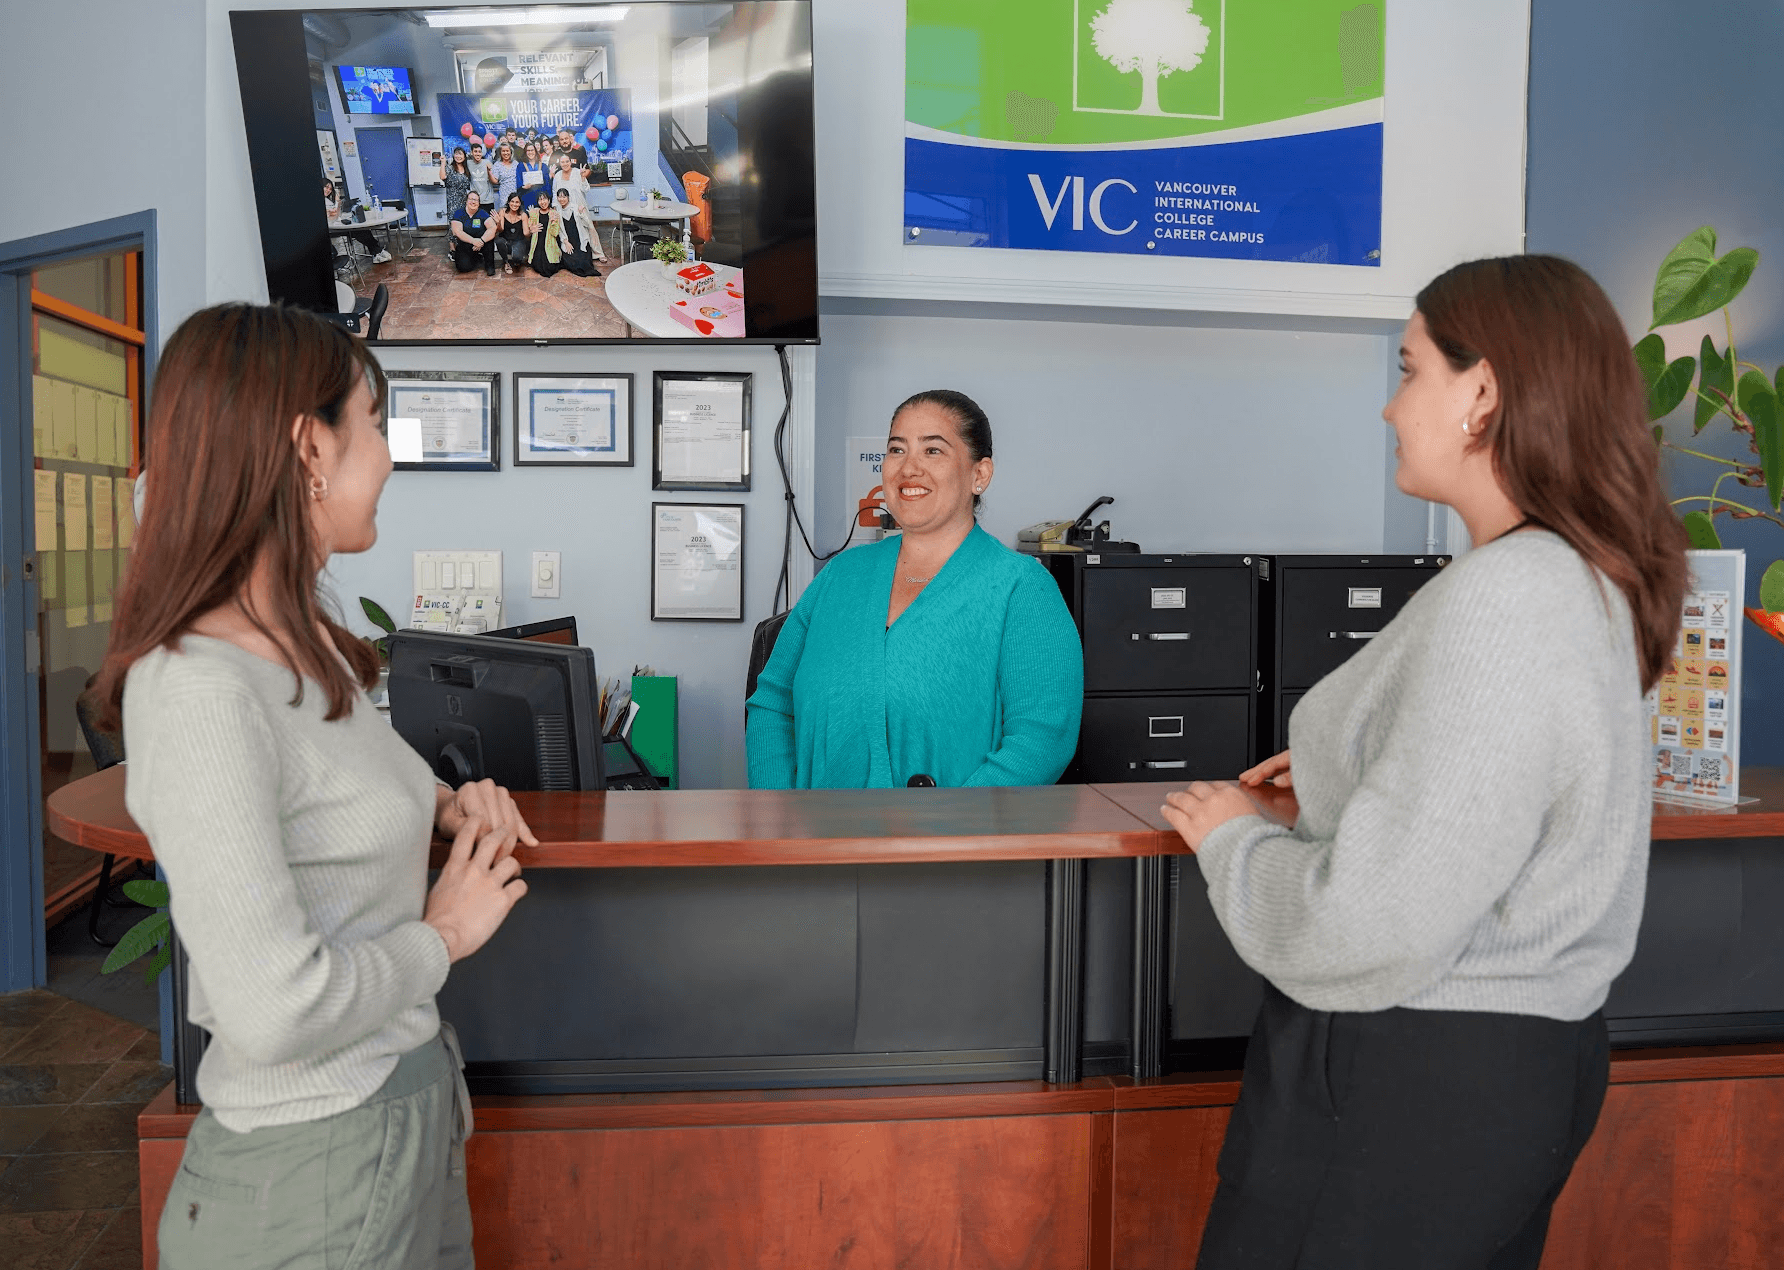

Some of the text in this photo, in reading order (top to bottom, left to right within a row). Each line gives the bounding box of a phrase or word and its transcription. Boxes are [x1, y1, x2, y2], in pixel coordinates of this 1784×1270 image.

[519, 54, 573, 63] RELEVANT
[520, 77, 589, 86] MEANINGUL
[510, 98, 583, 114] YOUR CAREER.
[511, 113, 539, 129] YOUR
[540, 112, 583, 128] FUTURE.
[1155, 180, 1237, 196] VANCOUVER
[1027, 174, 1139, 236] VIC
[1154, 196, 1261, 213] INTERNATIONAL
[1154, 212, 1215, 226] COLLEGE
[1154, 227, 1265, 244] CAREER CAMPUS
[860, 453, 886, 461] FIRST
[872, 464, 882, 472] KI
